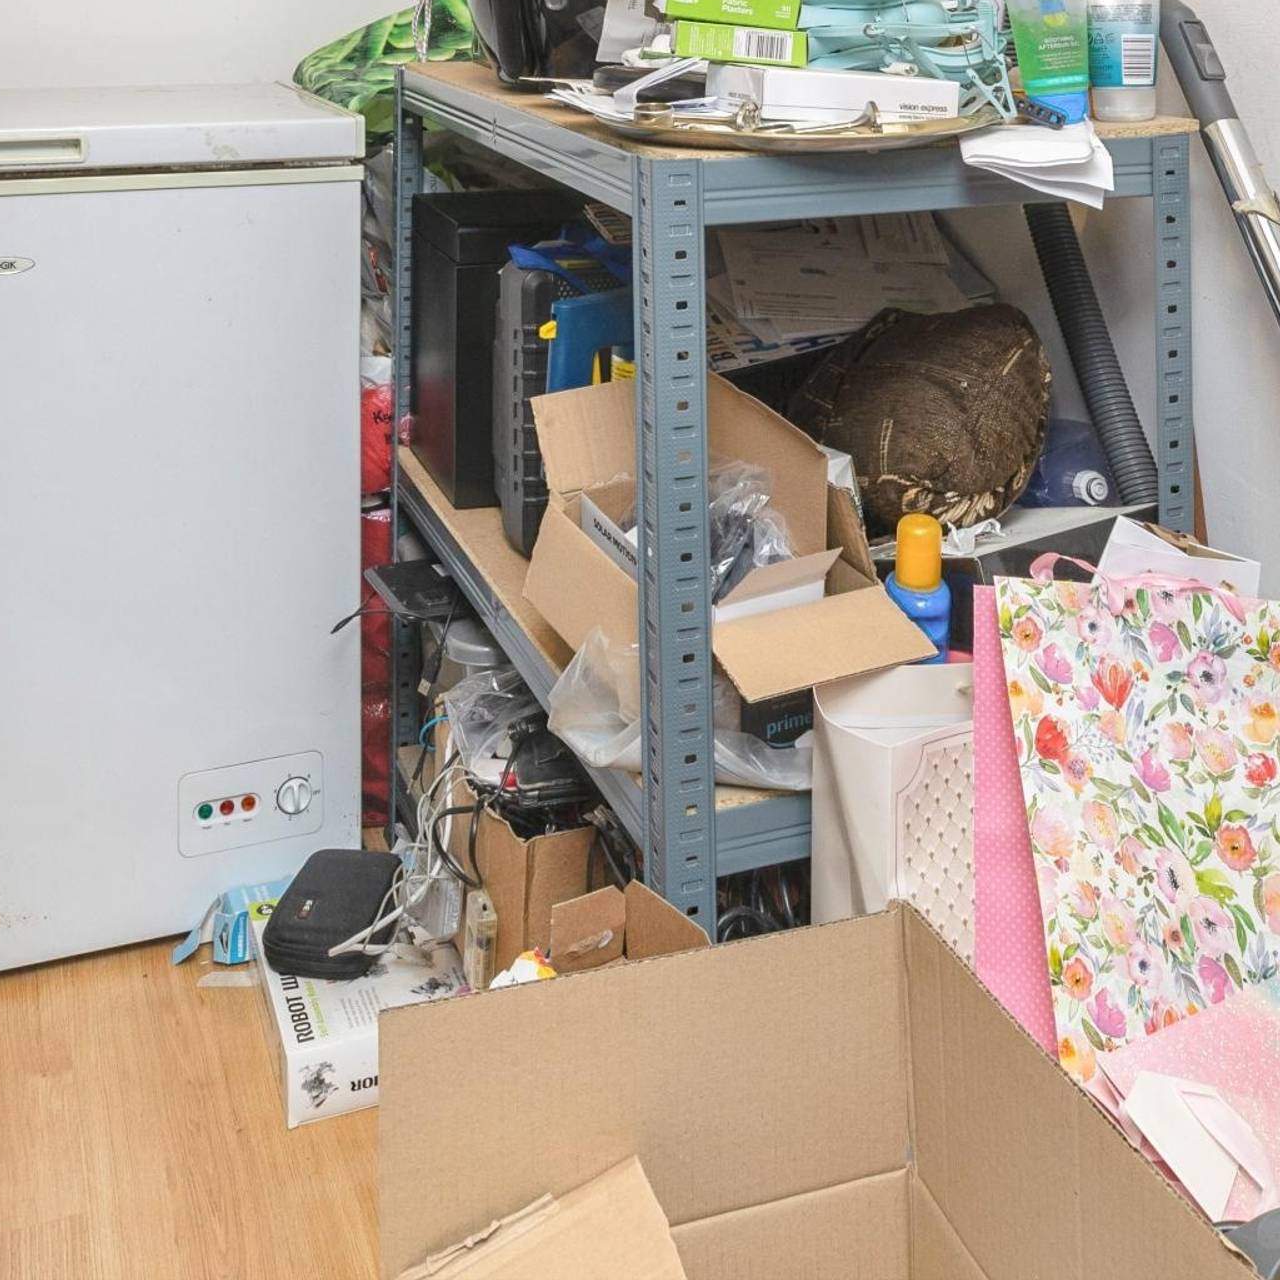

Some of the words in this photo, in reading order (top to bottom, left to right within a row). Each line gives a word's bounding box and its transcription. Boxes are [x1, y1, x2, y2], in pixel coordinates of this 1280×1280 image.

[721, 4, 753, 15] Plasters
[899, 103, 919, 111] vision
[920, 104, 948, 114] express
[286, 996, 315, 1044] ROBOT
